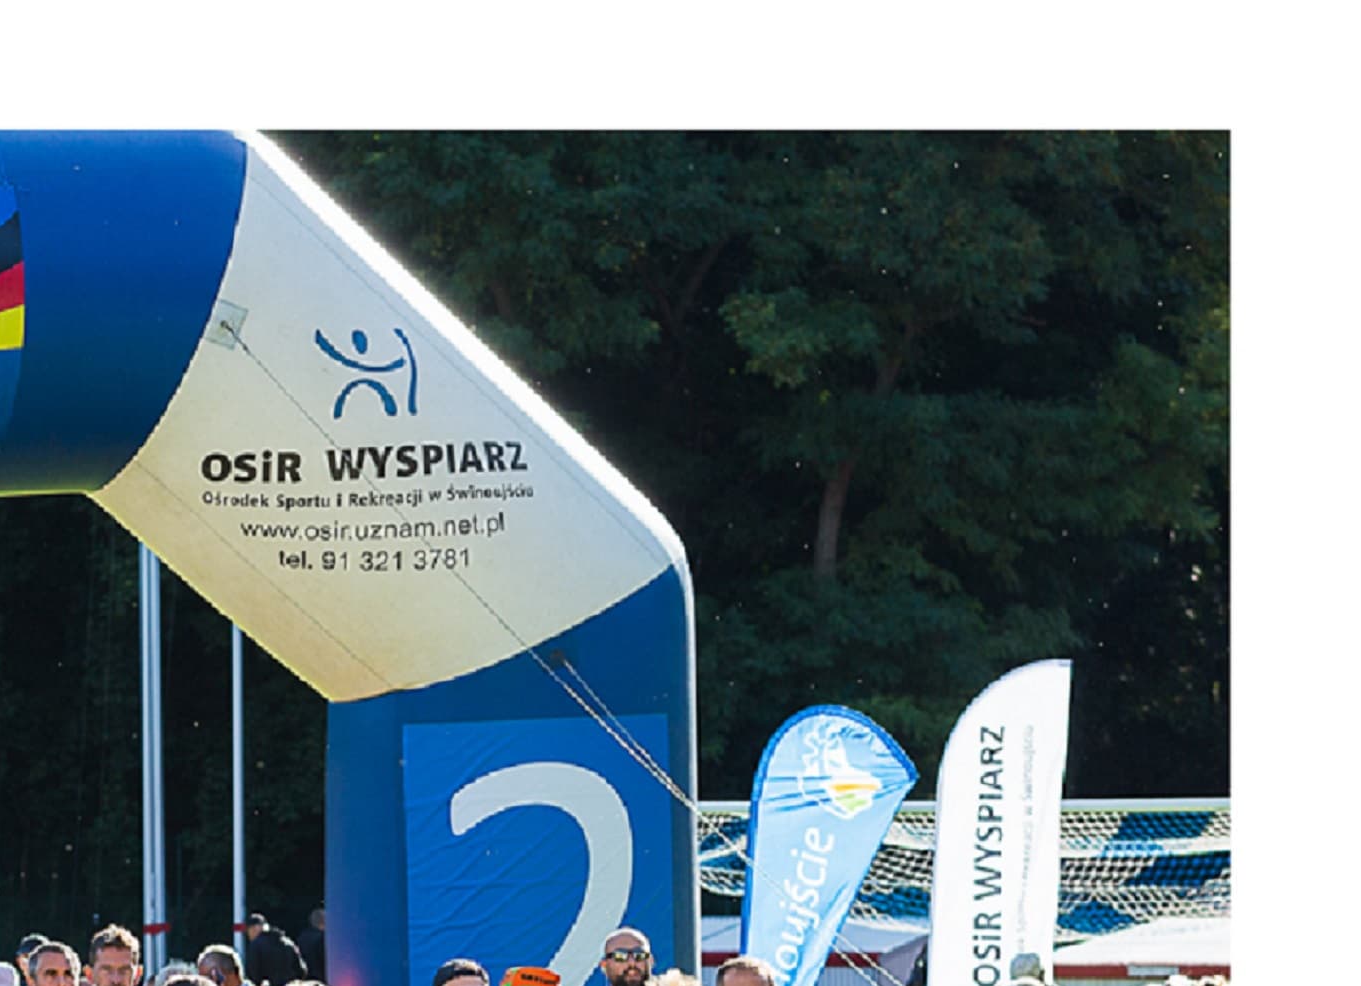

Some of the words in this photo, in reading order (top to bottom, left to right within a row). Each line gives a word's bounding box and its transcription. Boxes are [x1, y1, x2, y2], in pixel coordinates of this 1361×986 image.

[200, 450, 302, 484] OSiR
[326, 441, 528, 482] WYSPIARZ
[202, 490, 269, 508] Ośrodek
[276, 493, 330, 512] Sportu
[348, 489, 423, 508] Rekreacji
[240, 511, 506, 541] www.osir.uznam.net.pl
[279, 550, 313, 570] tel.
[321, 550, 349, 570] 91
[359, 550, 403, 571] 321
[413, 548, 470, 570] 3781
[973, 725, 1005, 901] WYSPIARZ
